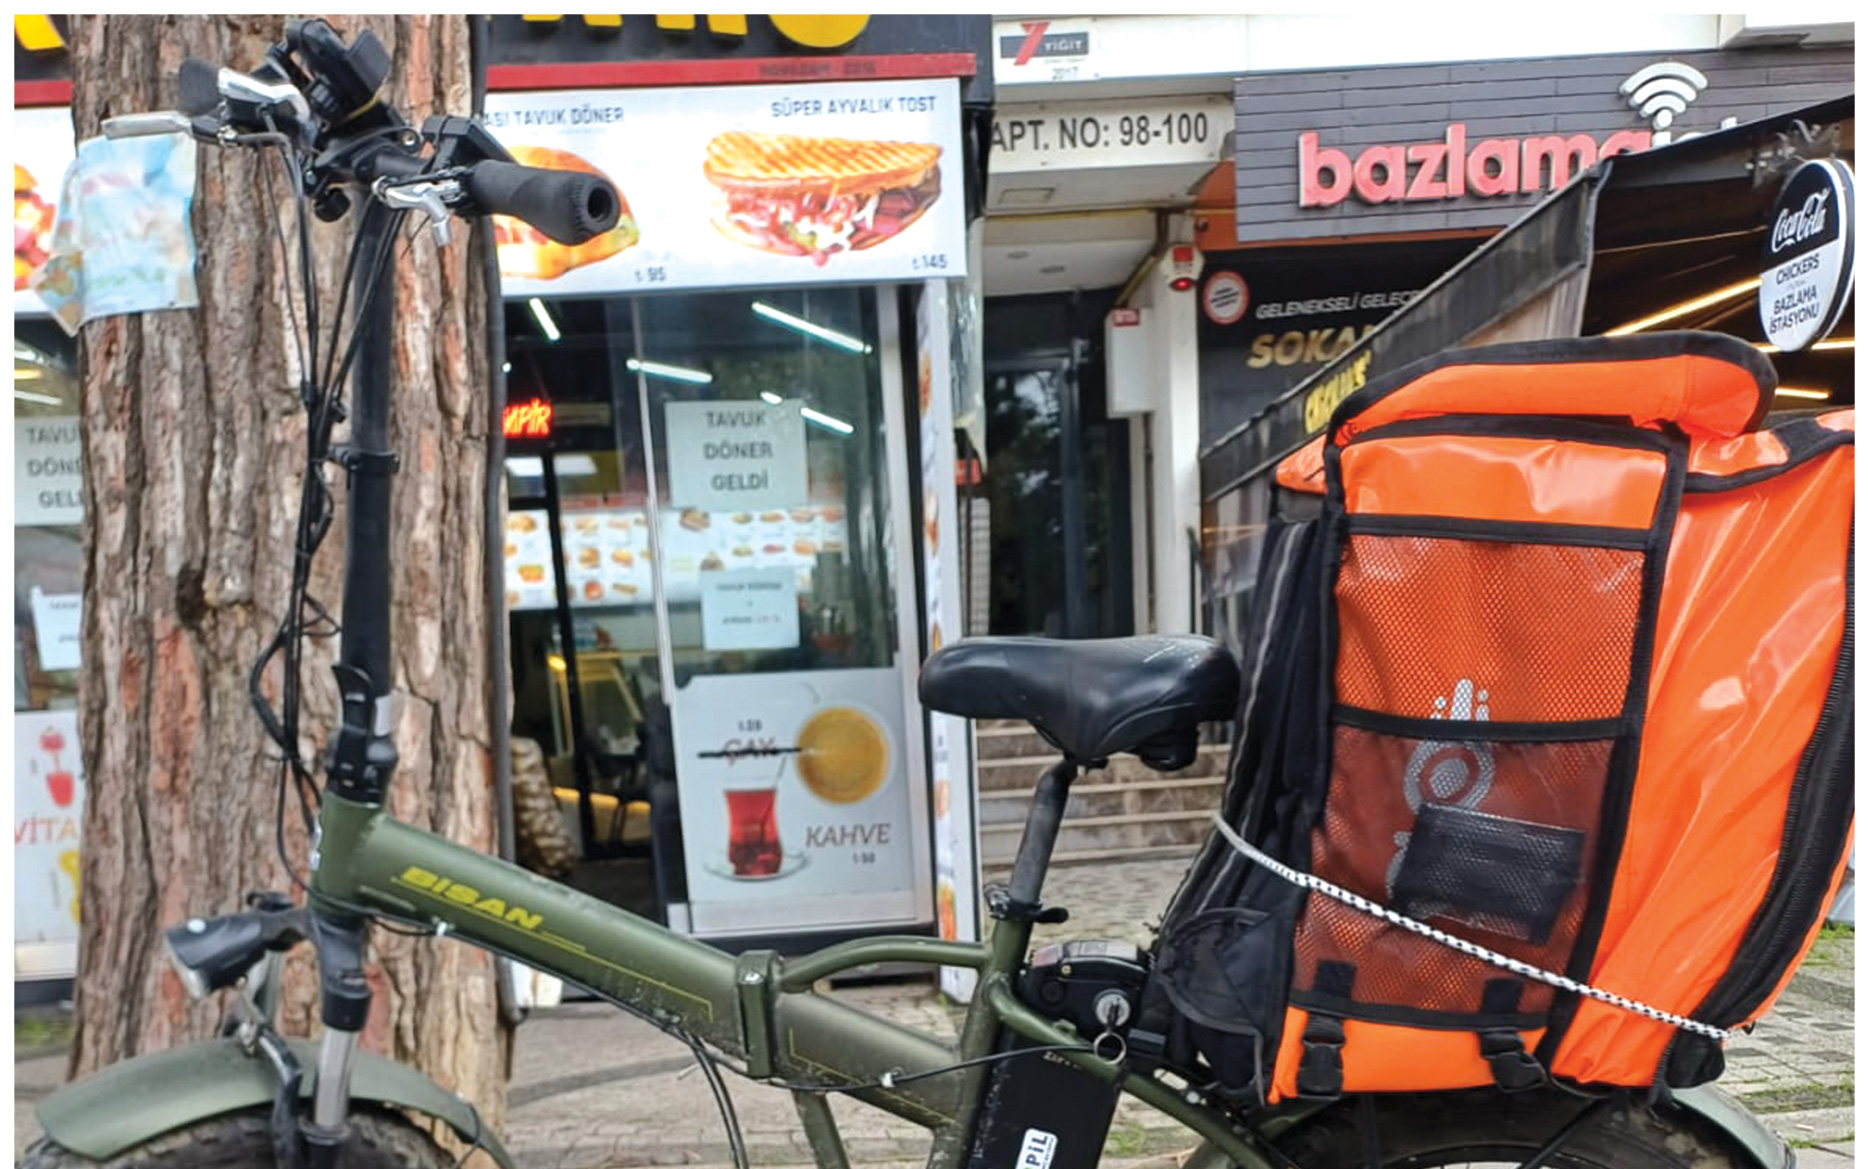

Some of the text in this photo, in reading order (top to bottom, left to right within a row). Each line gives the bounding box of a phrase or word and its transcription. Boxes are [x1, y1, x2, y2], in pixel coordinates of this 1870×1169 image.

[514, 109, 566, 125] TAVUK
[571, 103, 625, 124] DÖNER
[771, 95, 937, 117] SÜPER AYVALIK TOST
[1058, 117, 1110, 149] NO:
[1119, 112, 1208, 146] 98-100
[1776, 254, 1820, 285] CHICKERS
[1773, 285, 1818, 315] BAZLAMA
[1769, 303, 1820, 334] İSTASYONU
[1247, 324, 1376, 369] SOKA
[705, 411, 766, 428] TAVUK
[25, 426, 78, 445] TAVU
[703, 440, 773, 460] DÖNER
[711, 472, 769, 491] GELDİ
[806, 822, 891, 848] KAHVE
